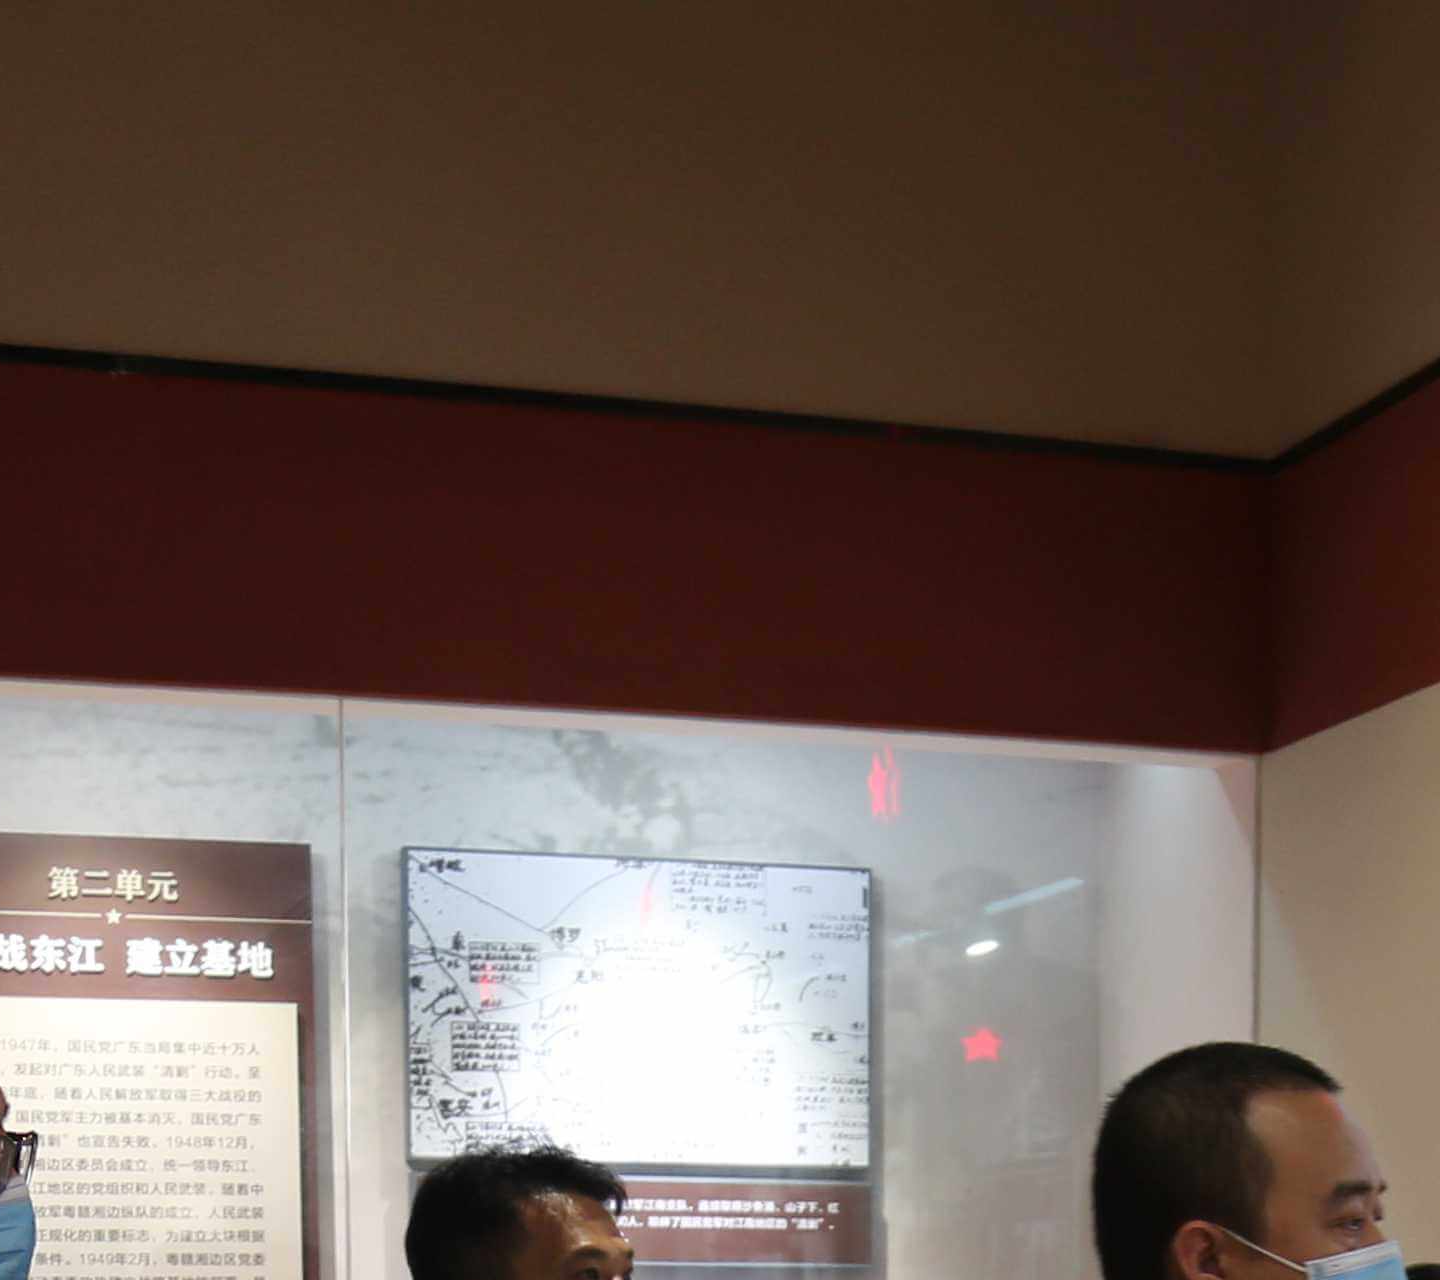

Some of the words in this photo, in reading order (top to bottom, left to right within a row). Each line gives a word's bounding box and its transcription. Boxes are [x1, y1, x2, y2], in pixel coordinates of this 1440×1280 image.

[47, 866, 180, 902] 第二单元
[125, 937, 275, 978] 建立基地
